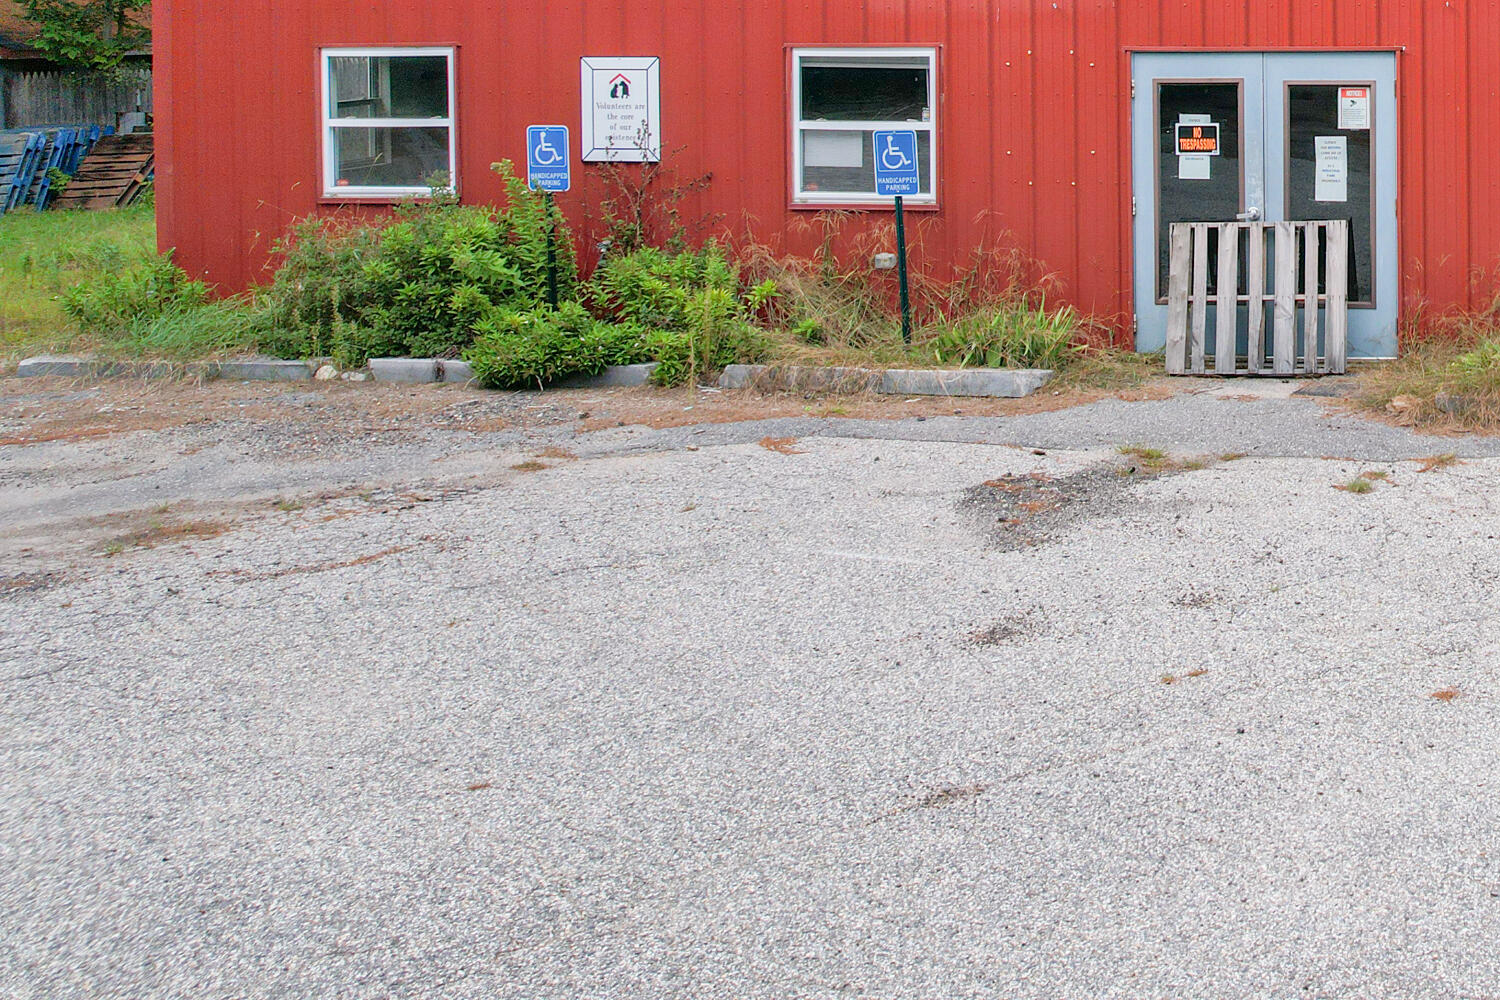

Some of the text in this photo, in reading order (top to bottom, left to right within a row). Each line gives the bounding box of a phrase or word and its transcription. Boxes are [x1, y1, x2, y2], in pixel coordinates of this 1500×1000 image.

[596, 102, 632, 110] Volunteers
[1192, 126, 1202, 138] NO
[1179, 137, 1216, 150] TRESPASSING
[878, 176, 917, 184] HANDICAPPED
